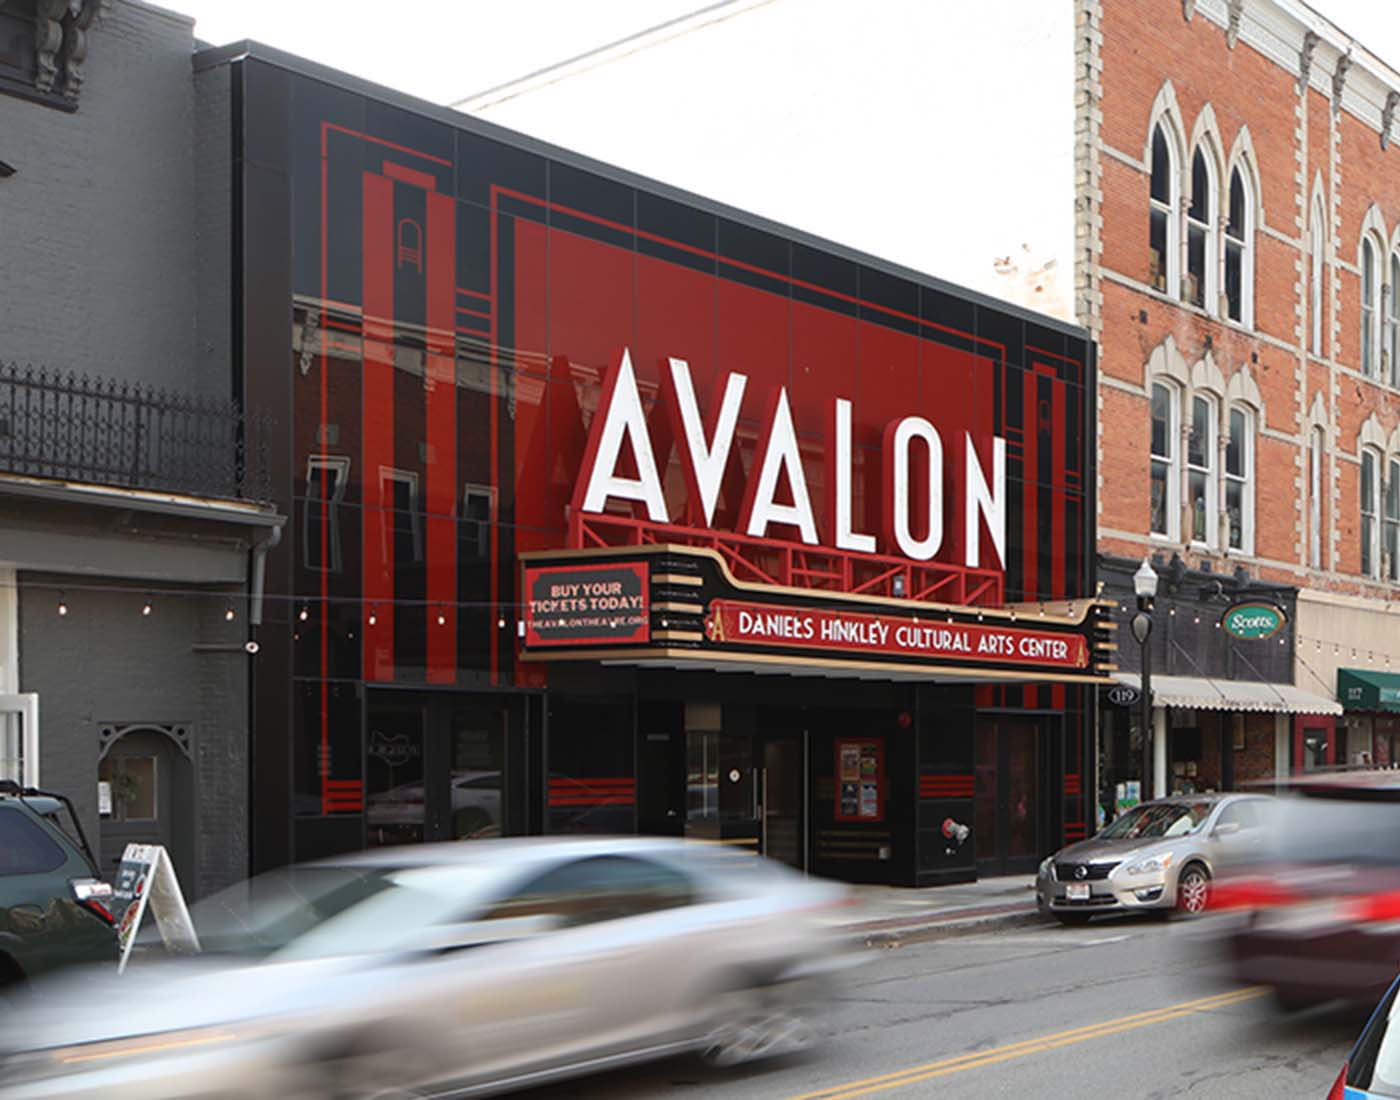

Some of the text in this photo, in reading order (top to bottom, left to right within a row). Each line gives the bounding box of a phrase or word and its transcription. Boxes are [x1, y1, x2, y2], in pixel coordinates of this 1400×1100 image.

[582, 346, 1006, 571] AVALON
[551, 582, 622, 598] BUY YOUR
[529, 596, 644, 613] TICKETS TODAY!
[527, 616, 649, 628] THEAVLONTHEARE.ORG
[739, 611, 1068, 659] DANIELS HINKLEY CULTURAL ARTS CENTER
